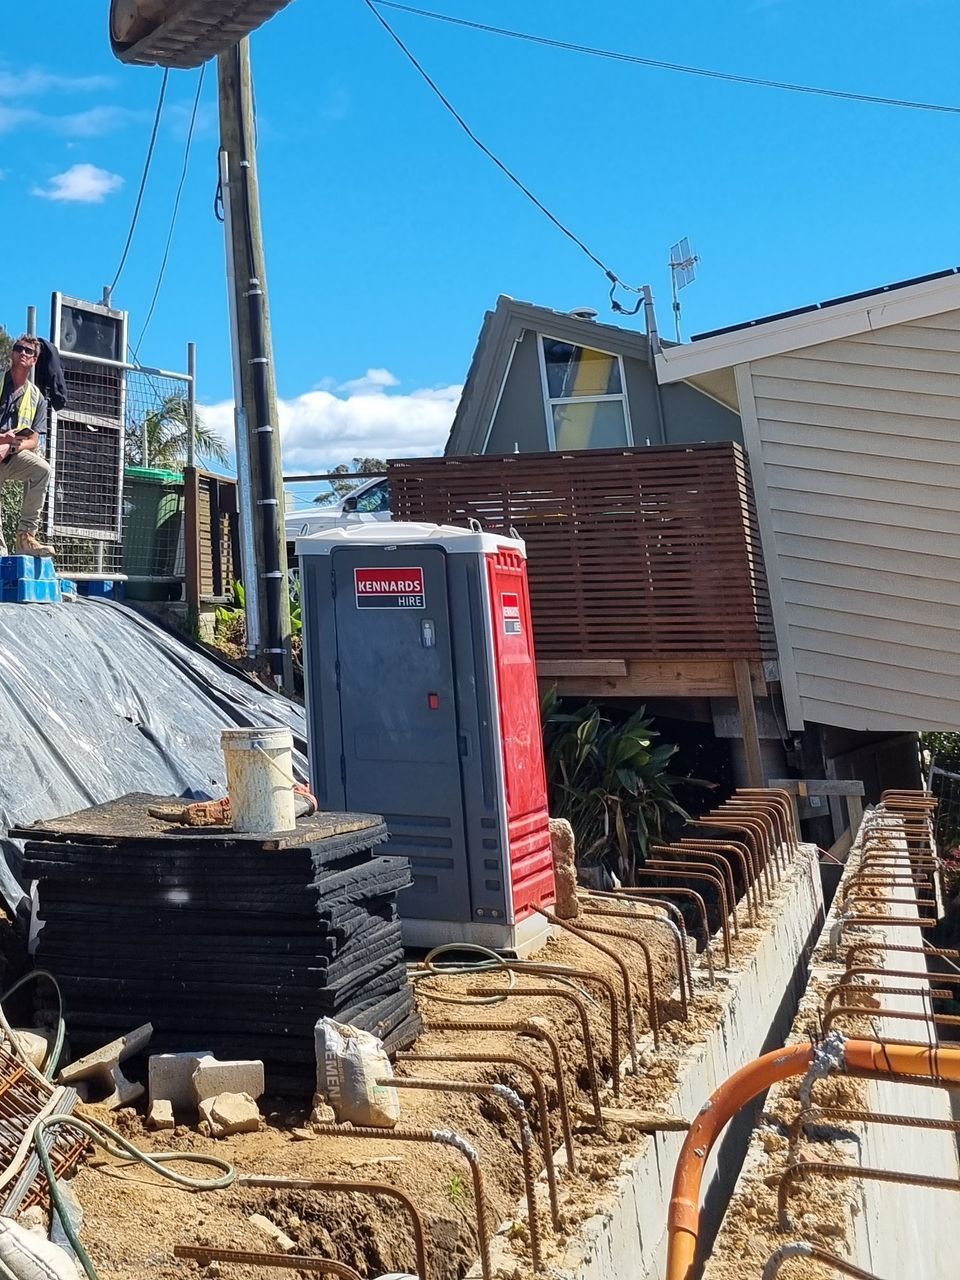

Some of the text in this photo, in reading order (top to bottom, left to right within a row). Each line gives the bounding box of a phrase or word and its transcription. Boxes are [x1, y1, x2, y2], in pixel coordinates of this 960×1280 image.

[357, 580, 421, 593] KENNARDS
[398, 596, 422, 607] HIRE
[325, 1041, 341, 1099] CEMEN
